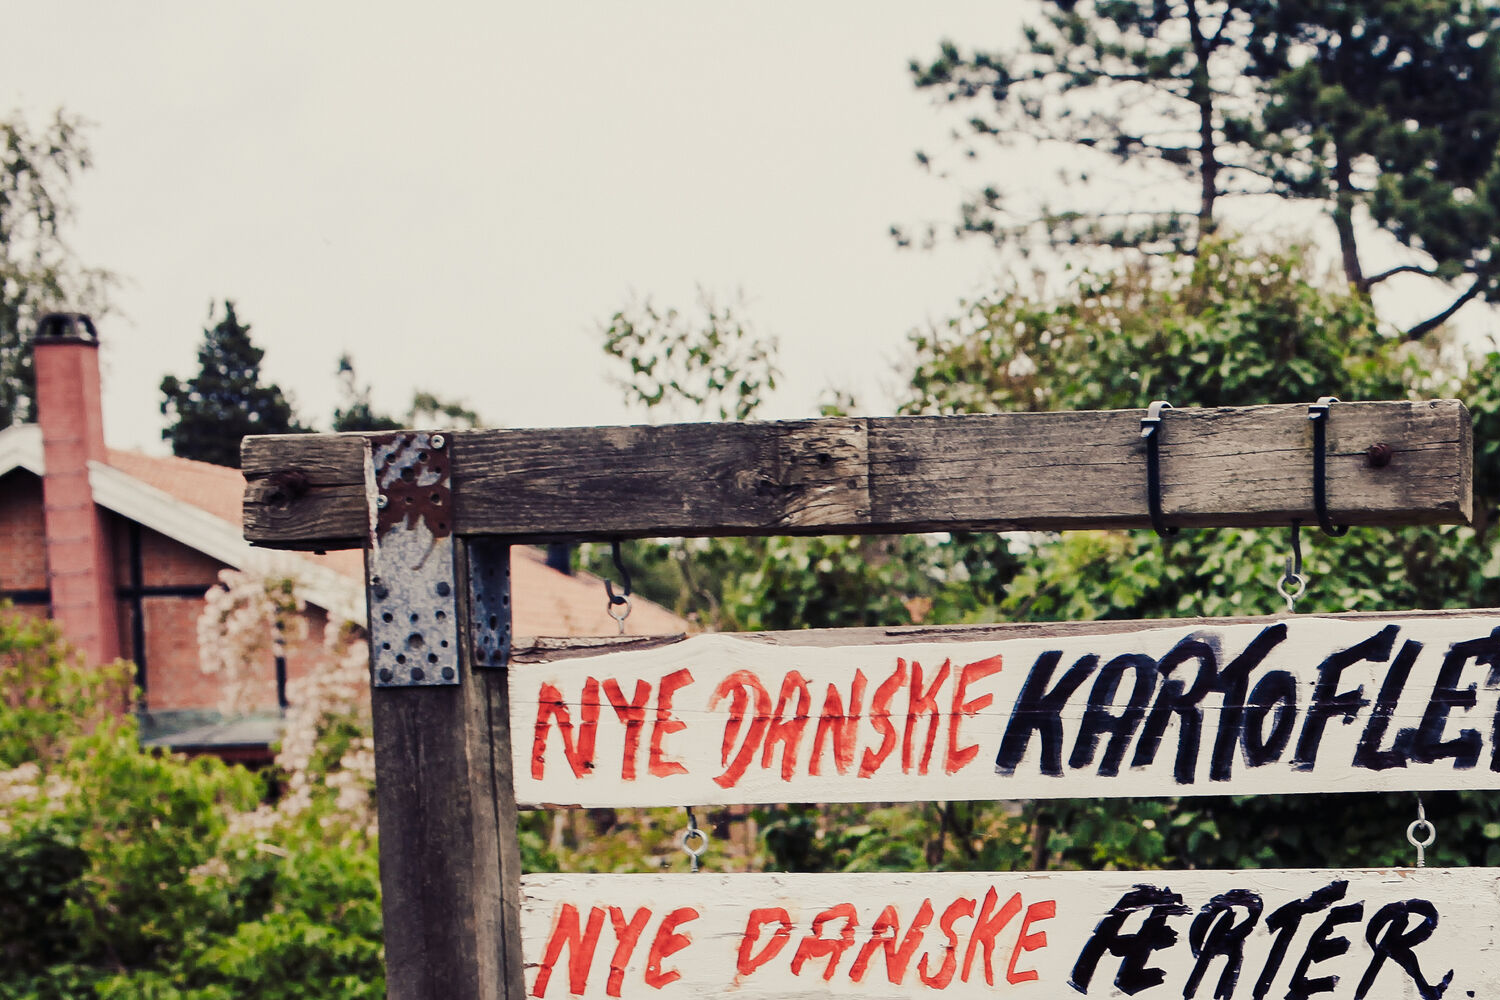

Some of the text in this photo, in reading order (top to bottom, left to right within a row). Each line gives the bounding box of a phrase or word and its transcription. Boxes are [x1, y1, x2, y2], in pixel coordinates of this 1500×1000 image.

[531, 667, 694, 780] NYE
[709, 654, 1003, 788] DANSKE
[533, 903, 699, 998] NYE
[736, 885, 1056, 991] DANSKE
